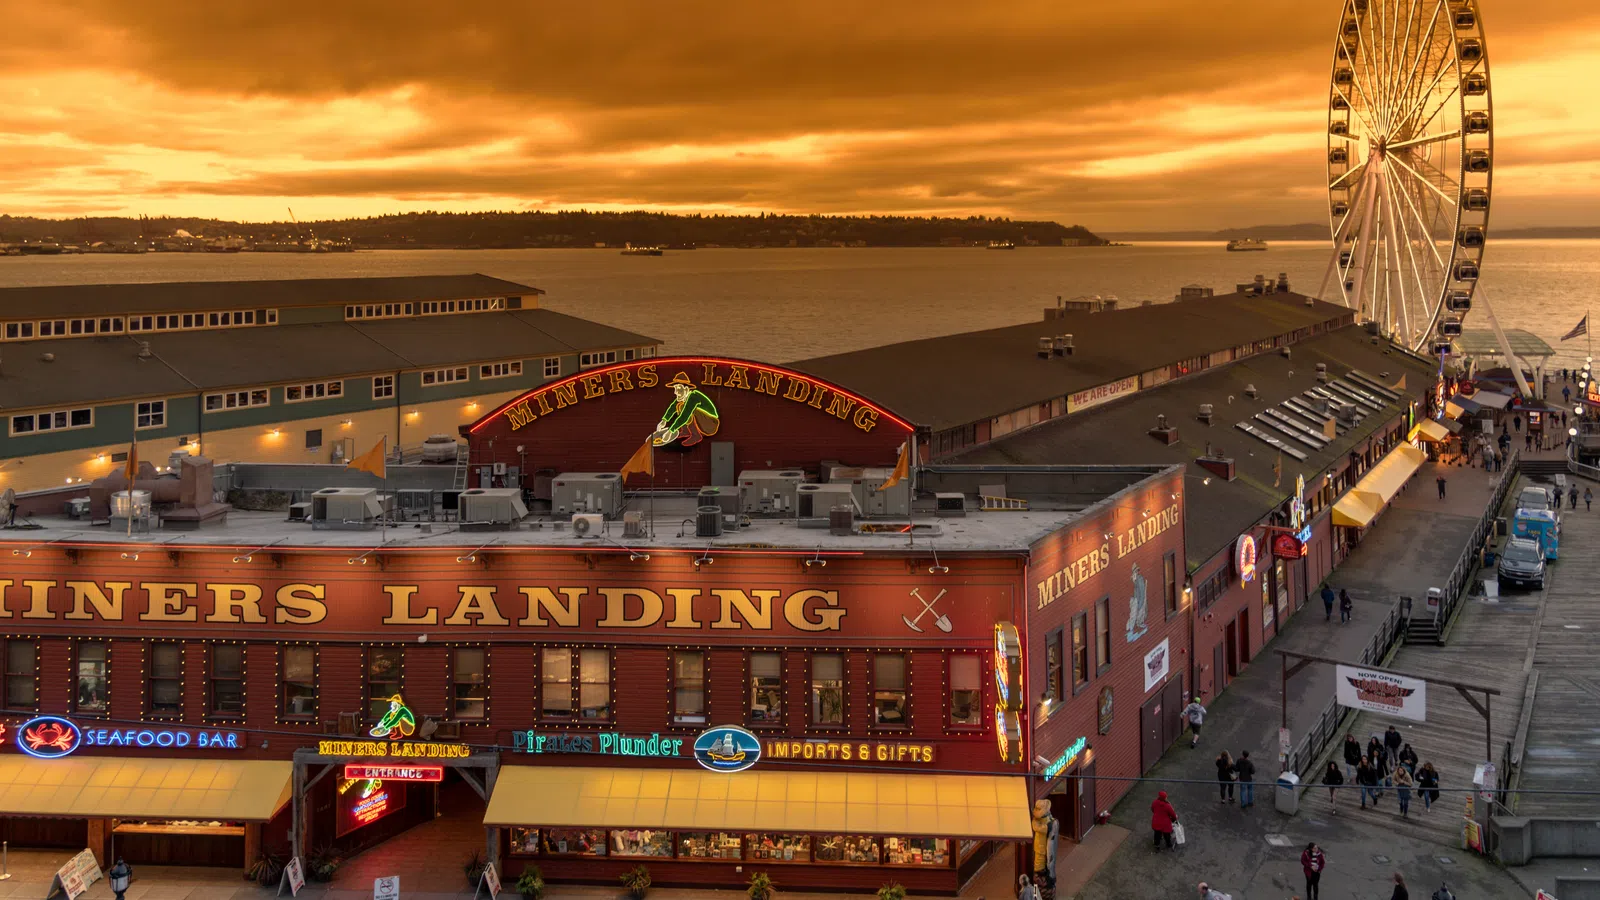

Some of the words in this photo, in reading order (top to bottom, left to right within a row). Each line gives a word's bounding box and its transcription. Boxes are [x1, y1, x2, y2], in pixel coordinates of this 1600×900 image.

[503, 364, 659, 431] MINERS
[701, 362, 879, 433] LANDING
[1073, 392, 1089, 406] WE
[1090, 386, 1108, 400] ARE
[1109, 377, 1135, 395] OPEN!
[1037, 542, 1110, 611] MINERS
[1117, 503, 1179, 560] LANDING
[382, 584, 847, 632] LANDING
[1378, 675, 1403, 685] OPEN!
[86, 729, 191, 747] SEAFOOD
[198, 731, 238, 749] BAR
[318, 741, 388, 757] MINERS
[390, 741, 470, 758] LANDING
[512, 730, 594, 754] Pirates
[599, 733, 683, 757] Plunder
[767, 741, 852, 761] IMPORTS
[858, 745, 869, 761] &
[876, 744, 934, 763] GIFTS
[364, 768, 423, 779] ENTRANCE
